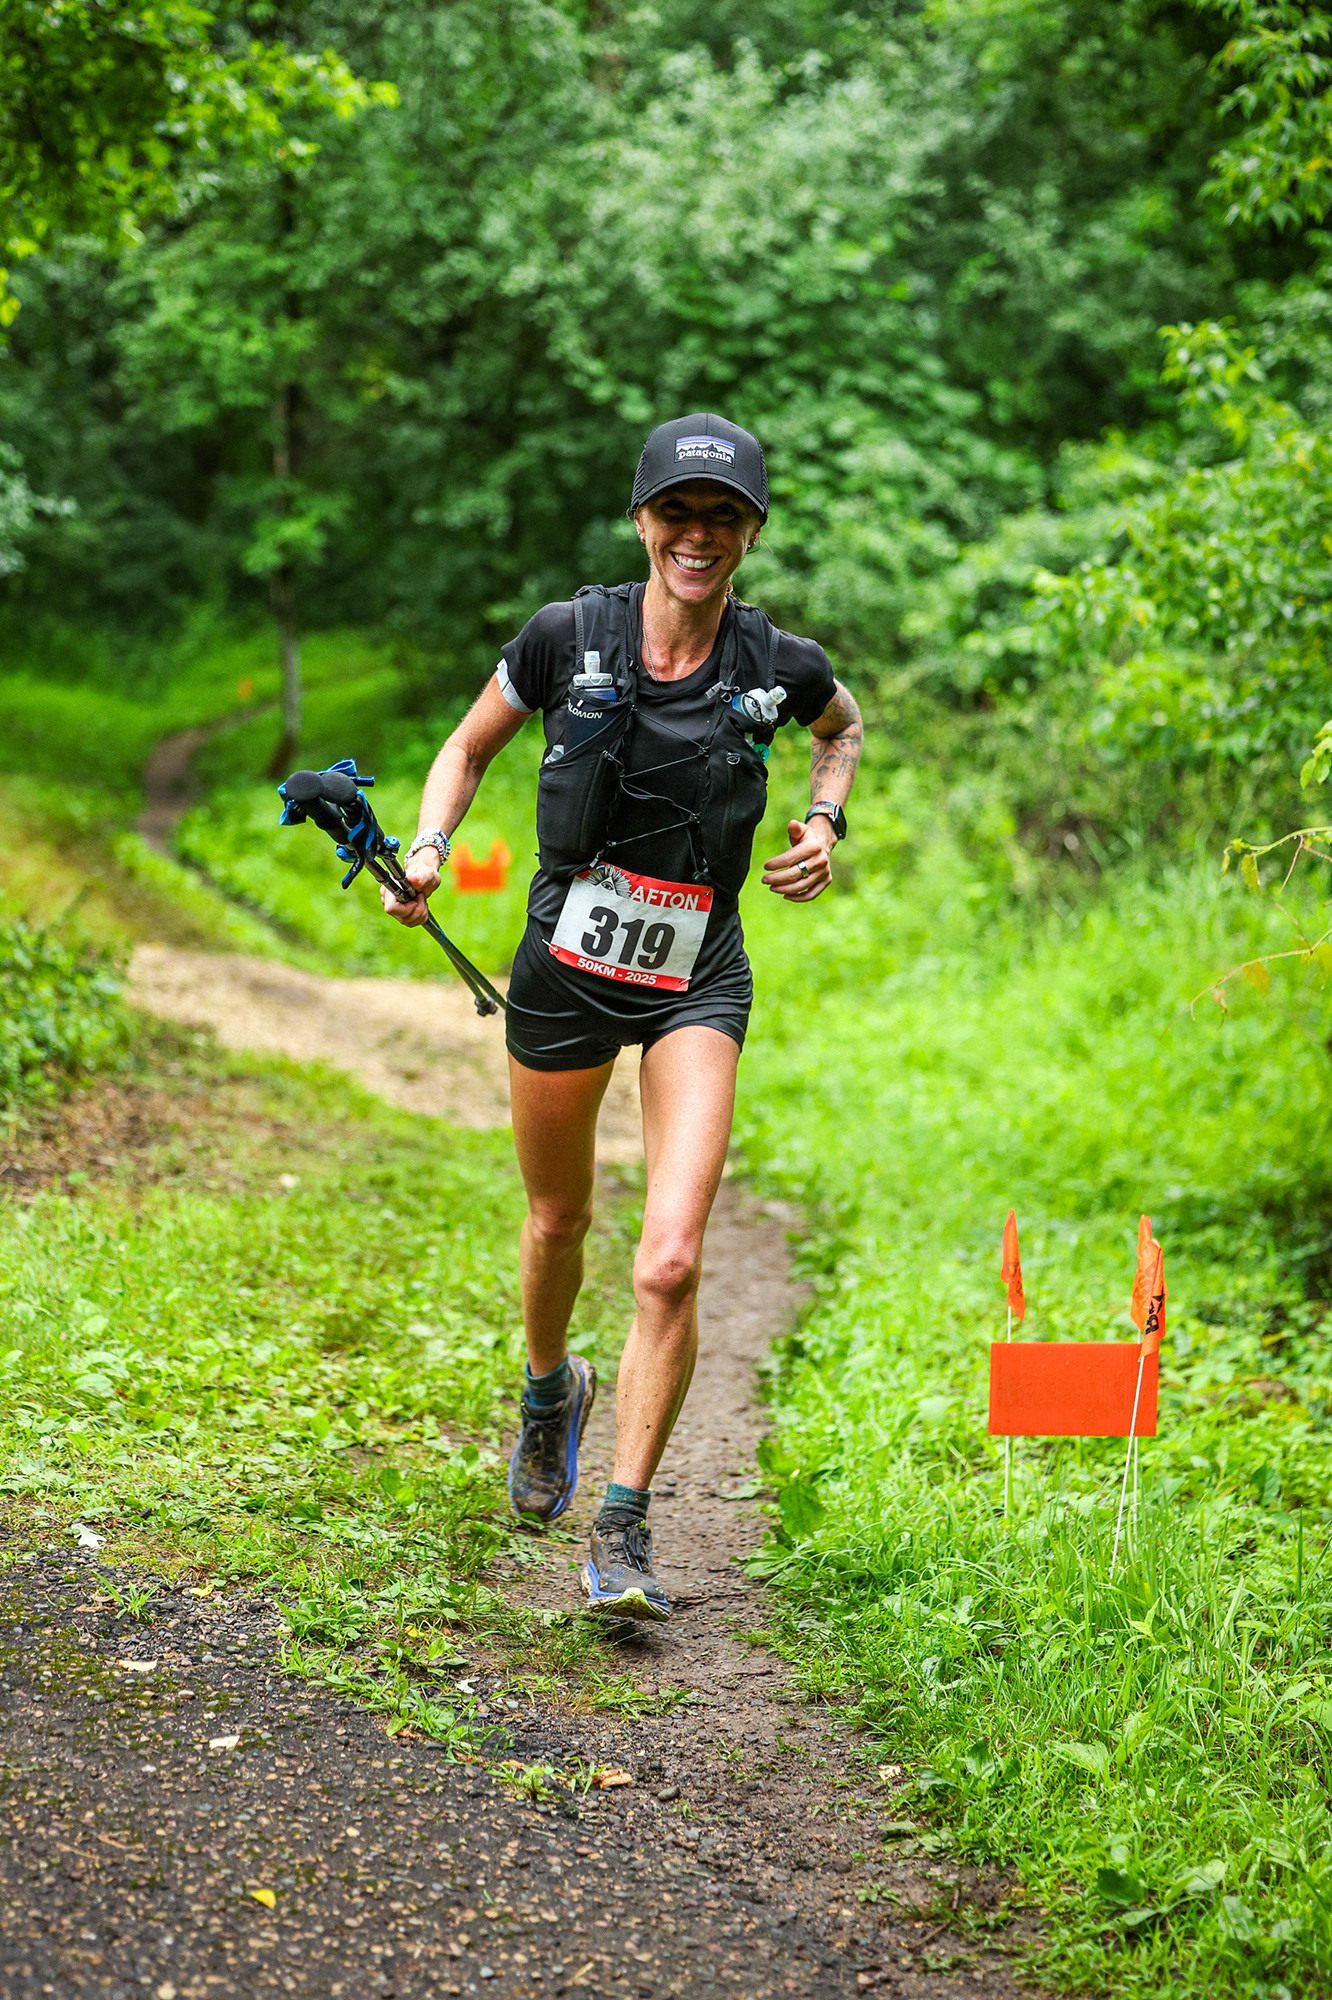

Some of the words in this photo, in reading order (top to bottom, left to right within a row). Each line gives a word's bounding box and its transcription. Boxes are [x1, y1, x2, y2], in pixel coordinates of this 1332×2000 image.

[678, 448, 732, 463] patagonia
[630, 885, 699, 911] AFTON
[581, 906, 675, 969] 319
[577, 957, 616, 977] 50KM
[624, 971, 657, 985] 2025
